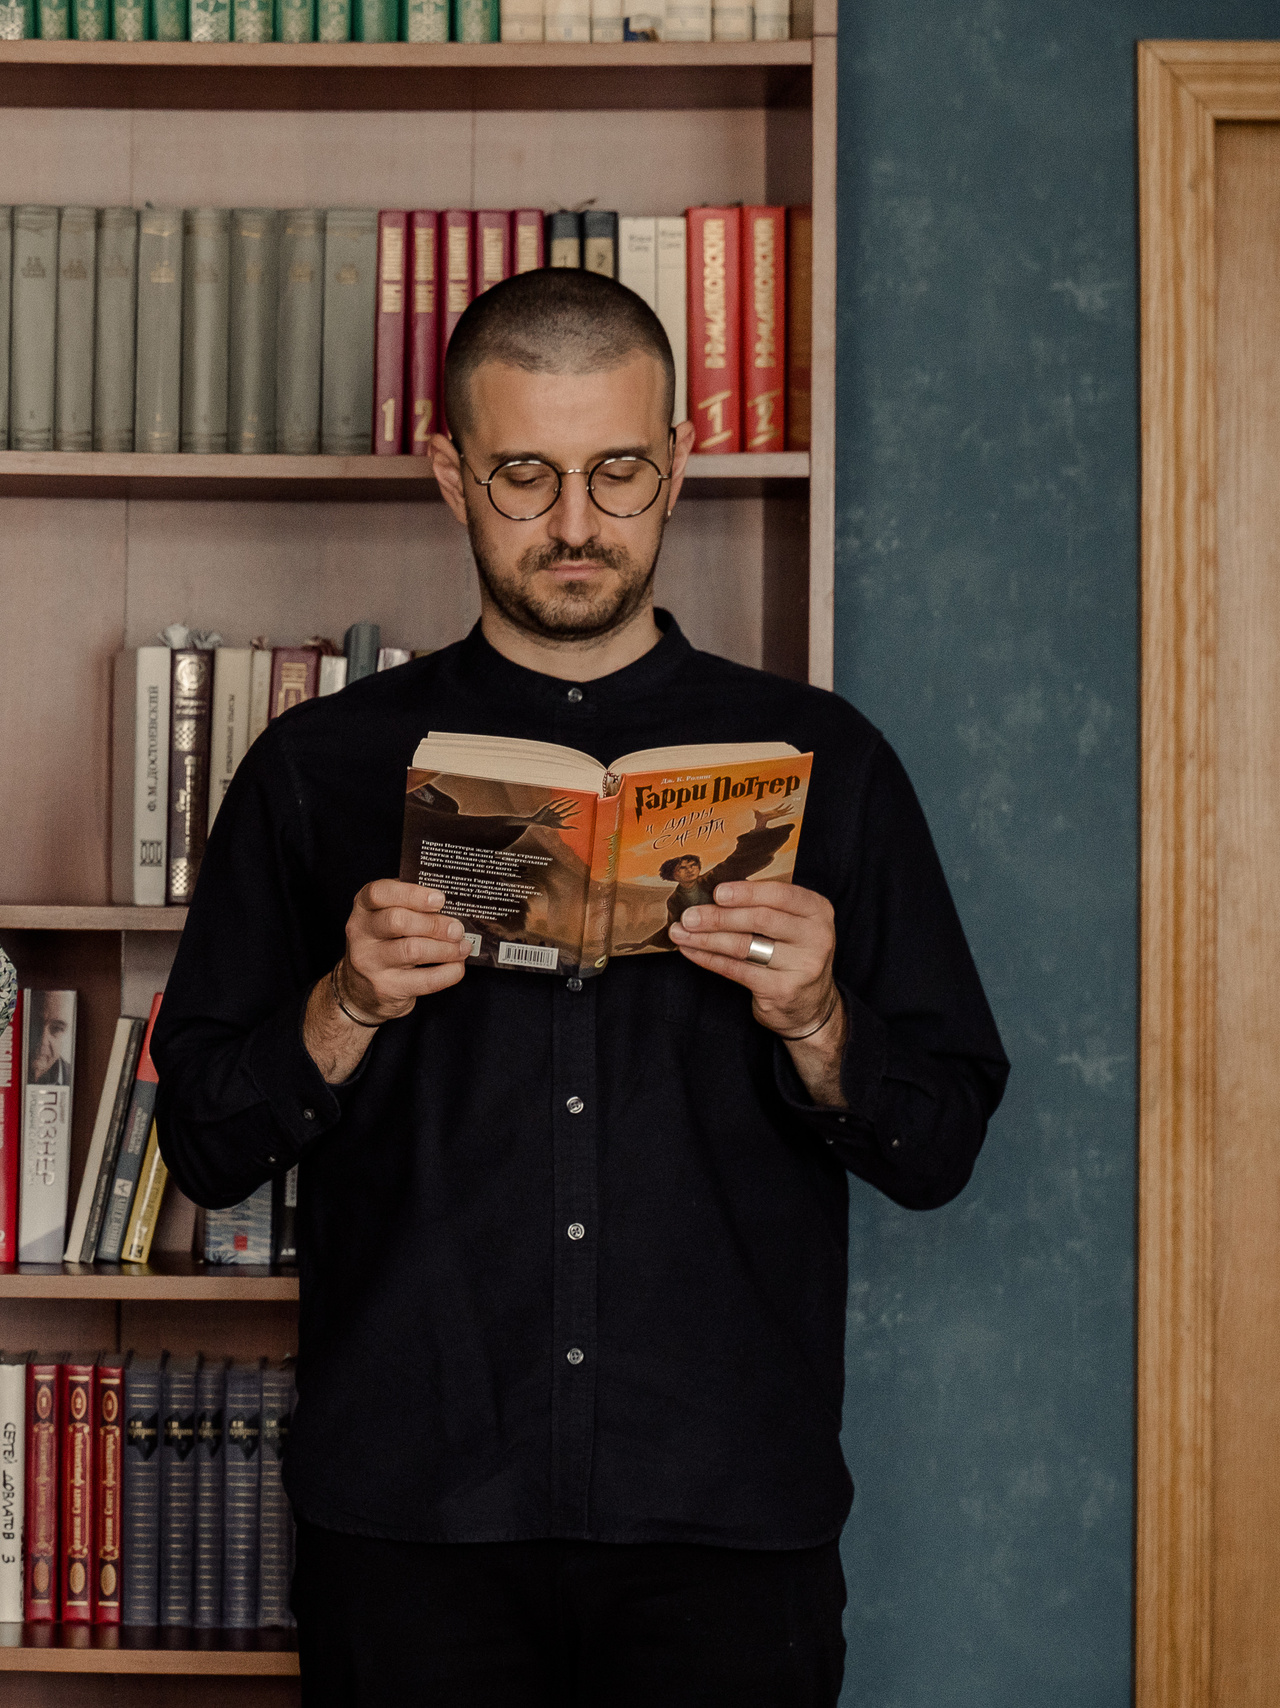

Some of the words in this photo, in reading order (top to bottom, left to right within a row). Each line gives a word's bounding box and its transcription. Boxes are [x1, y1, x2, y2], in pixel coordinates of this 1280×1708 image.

[380, 398, 396, 441] 1
[147, 685, 159, 781] ДОСТОЕВСКИЙ
[686, 773, 712, 782] Ролинг
[635, 783, 708, 824] Гарри
[710, 774, 801, 804] Поттер
[646, 824, 653, 834] и
[661, 807, 715, 834] ДАРЫ
[652, 817, 726, 850] СМЕРТИ
[420, 850, 449, 858] схватка
[421, 839, 444, 847] Гарри
[444, 842, 474, 852] Поттера
[517, 853, 554, 862] страшное
[421, 845, 460, 855] испытание
[501, 856, 548, 866] смертельная
[418, 870, 444, 879] Друзья
[473, 877, 495, 886] Гарри
[420, 860, 442, 869] Гарри
[35, 1090, 58, 1187] ПОЗНЕР
[2, 1422, 17, 1464] СЕРГЕЙ
[2, 1470, 15, 1540] ДОВЛАТОВ
[2, 1553, 16, 1564] 3
